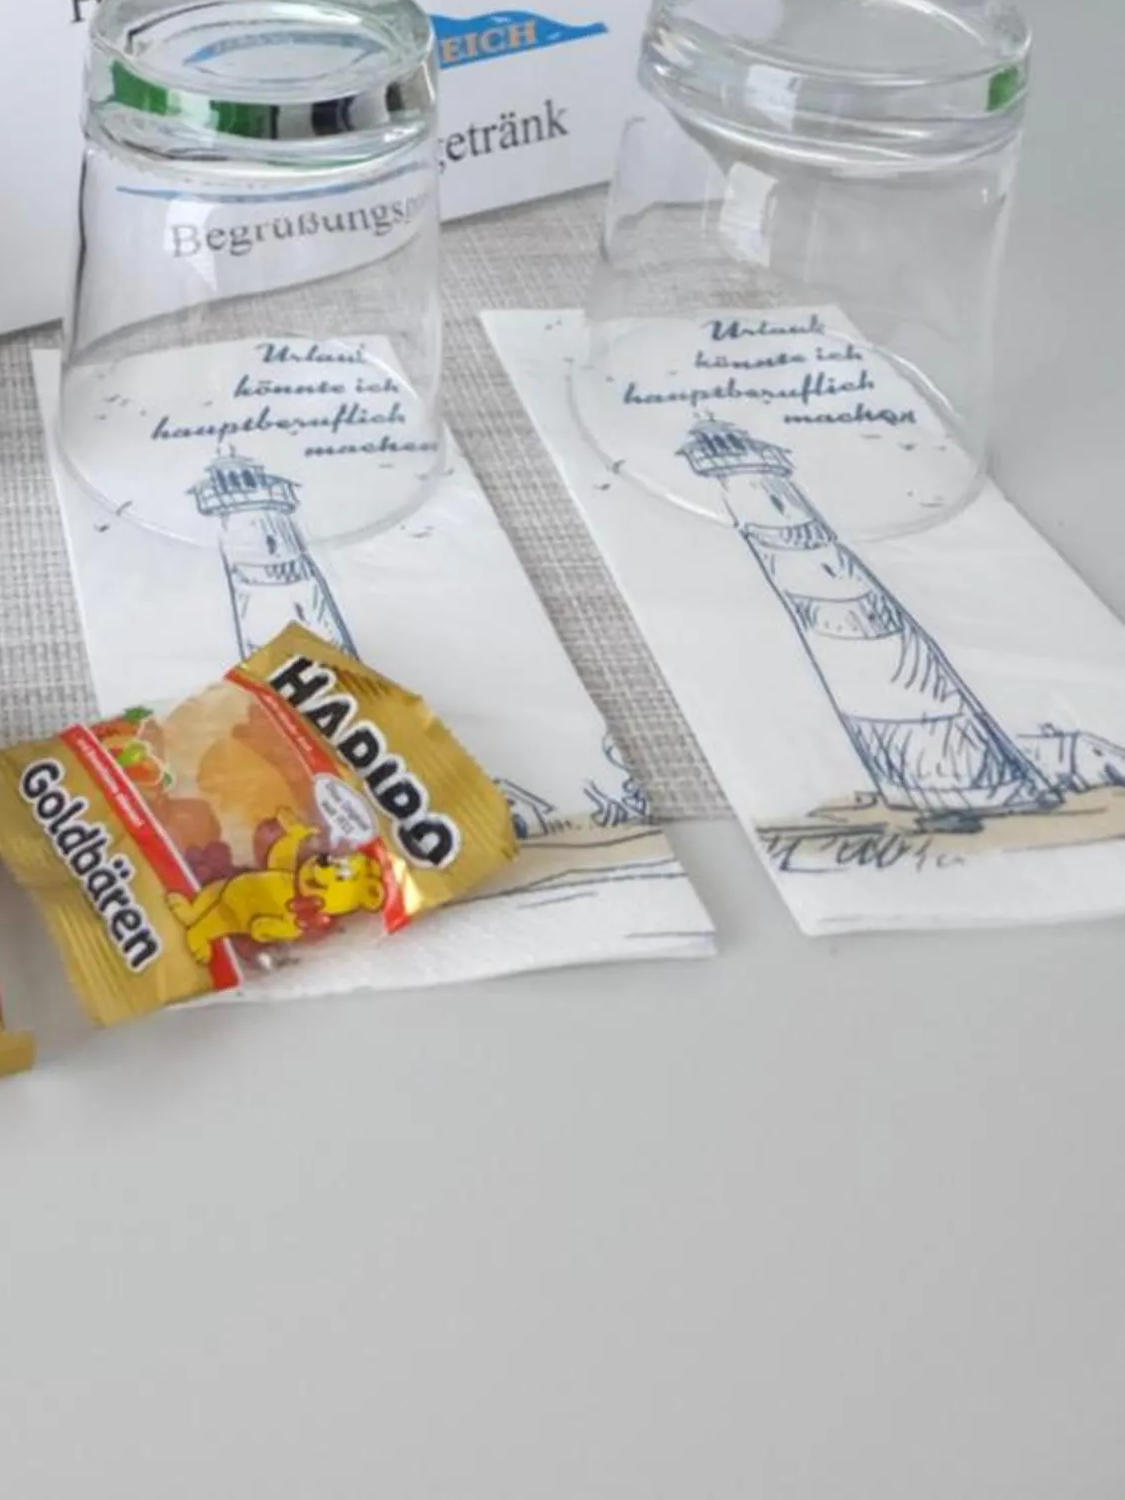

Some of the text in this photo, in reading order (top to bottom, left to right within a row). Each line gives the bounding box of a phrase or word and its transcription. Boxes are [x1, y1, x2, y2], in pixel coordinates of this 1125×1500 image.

[814, 344, 864, 362] ich
[233, 374, 401, 399] könnte ich
[150, 401, 408, 443] hauptberuflich
[21, 760, 161, 972] Goldbären
